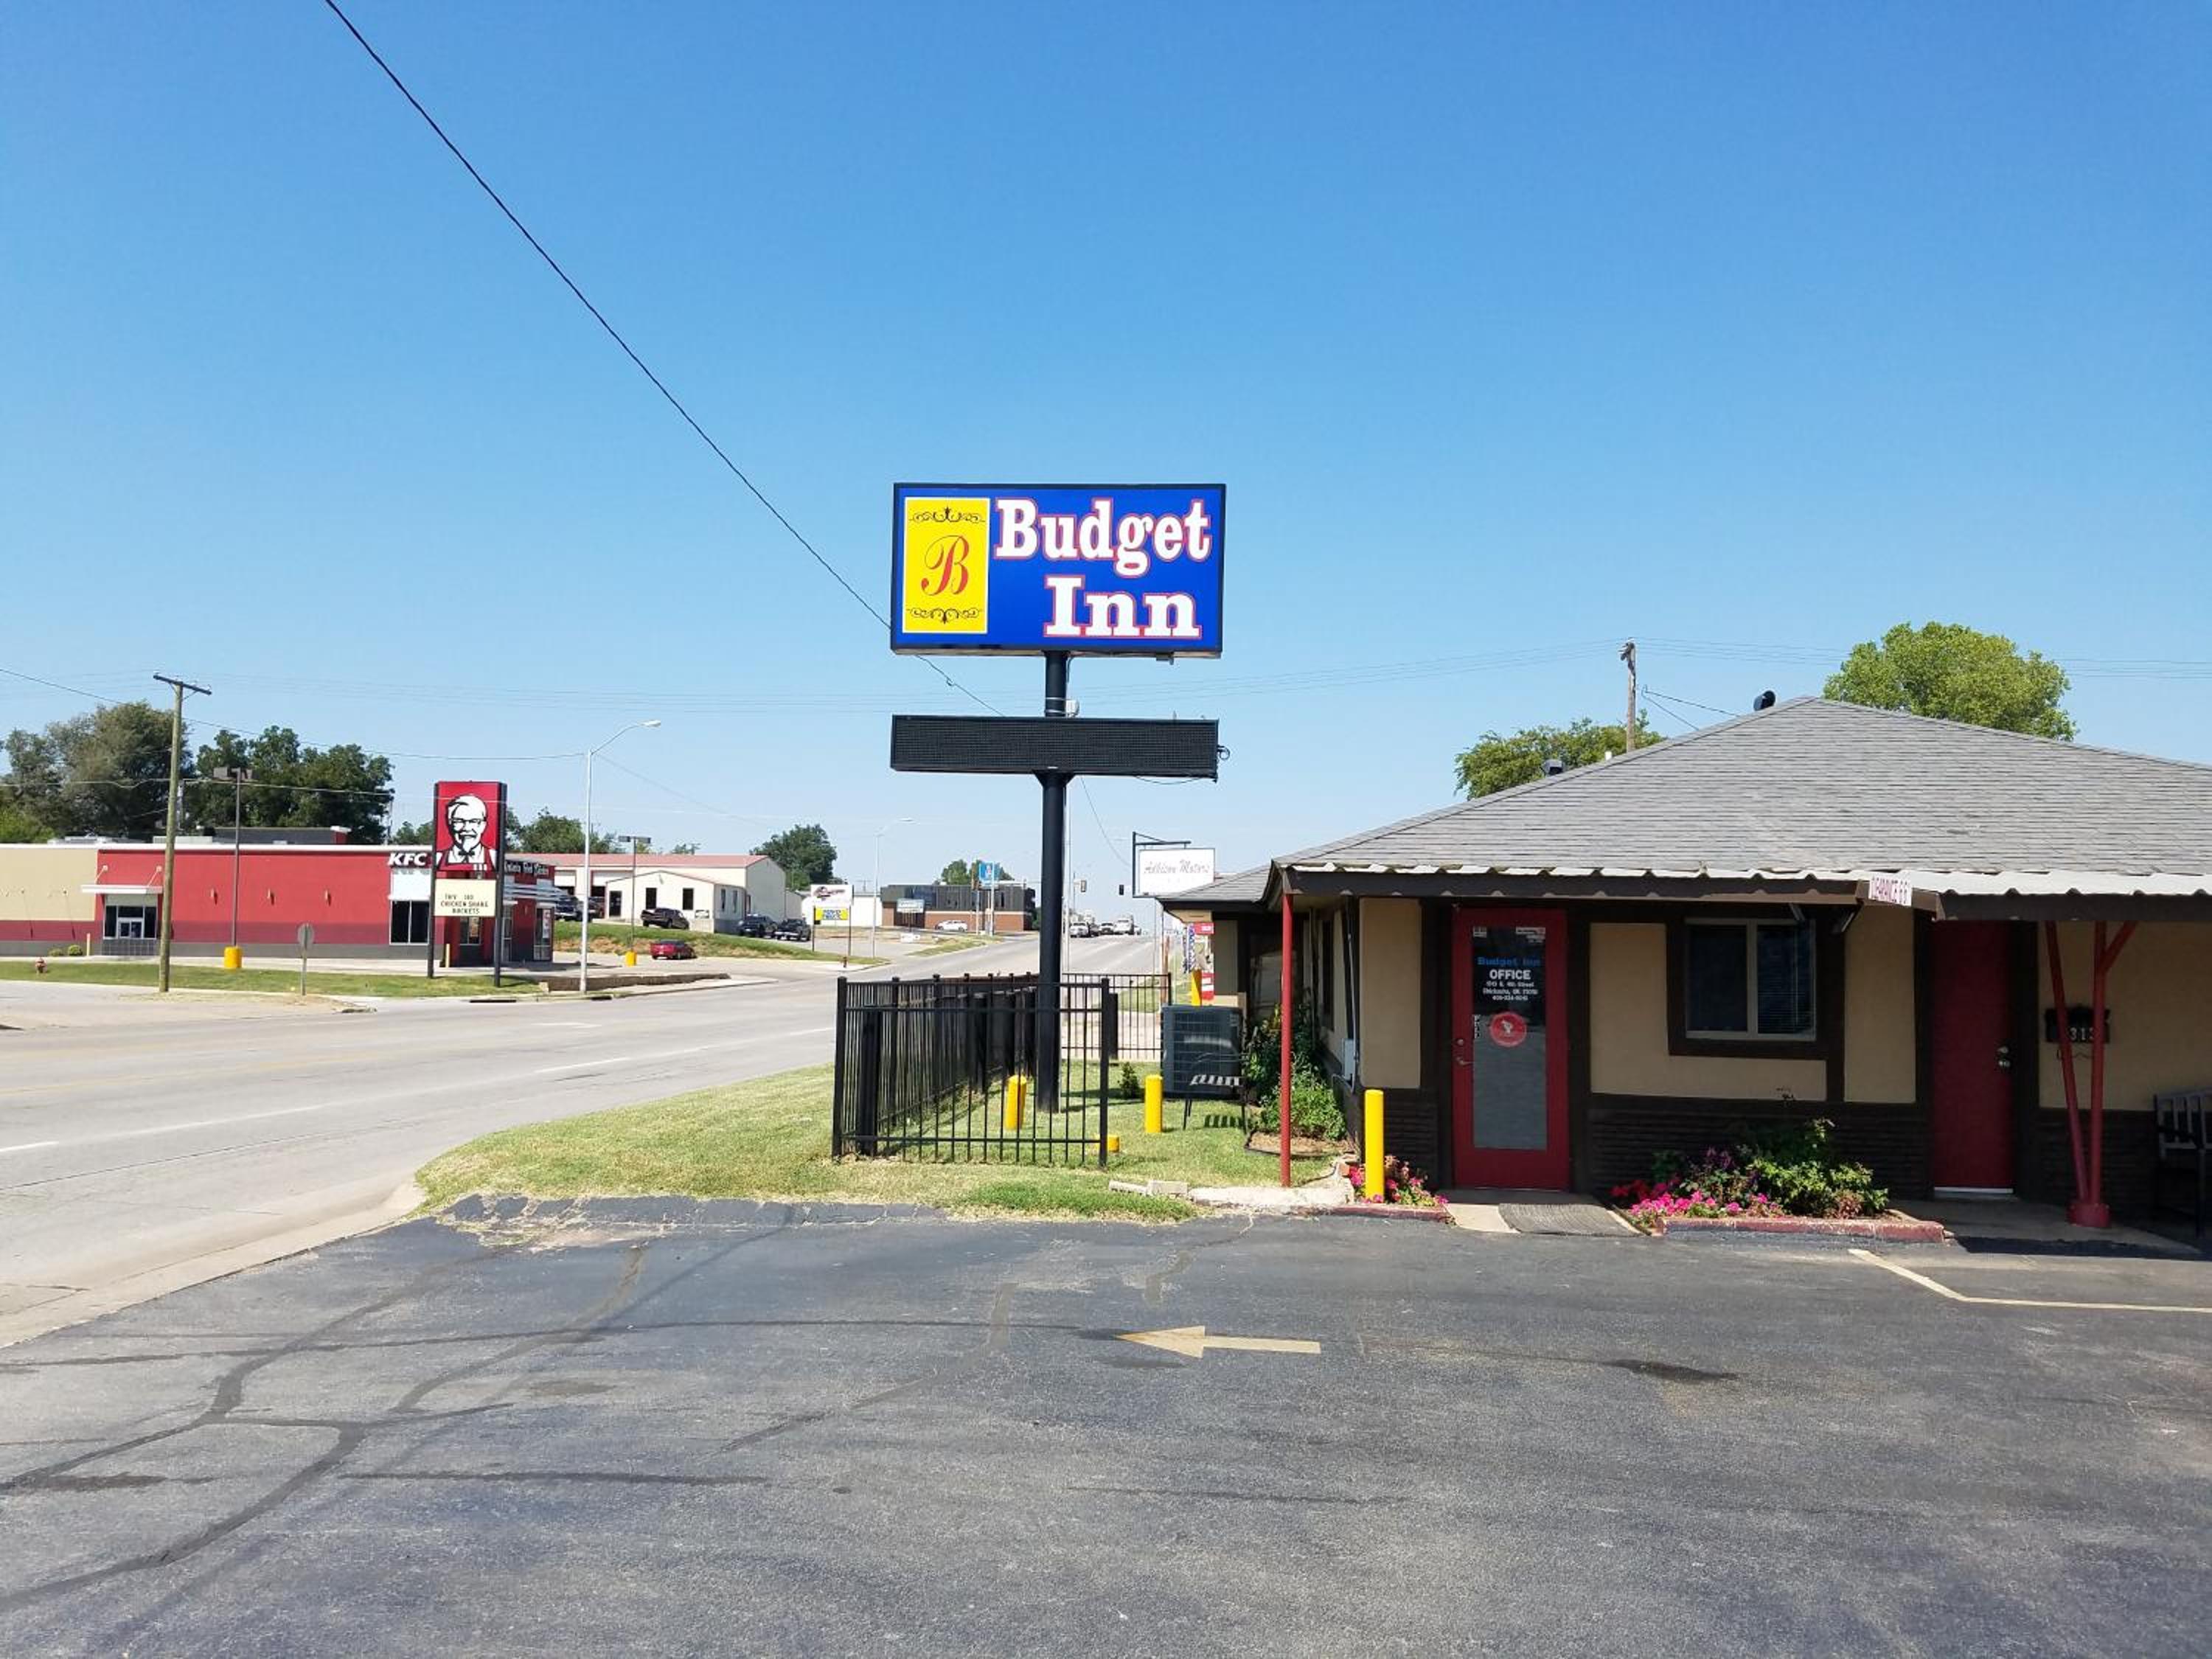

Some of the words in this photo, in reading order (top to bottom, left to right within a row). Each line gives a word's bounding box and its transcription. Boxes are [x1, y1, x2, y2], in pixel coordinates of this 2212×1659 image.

[921, 535, 970, 596] B
[995, 497, 1211, 578] Budget
[1043, 574, 1202, 639] Inn
[388, 852, 427, 866] KFC
[1489, 969, 1531, 980] OFFICE
